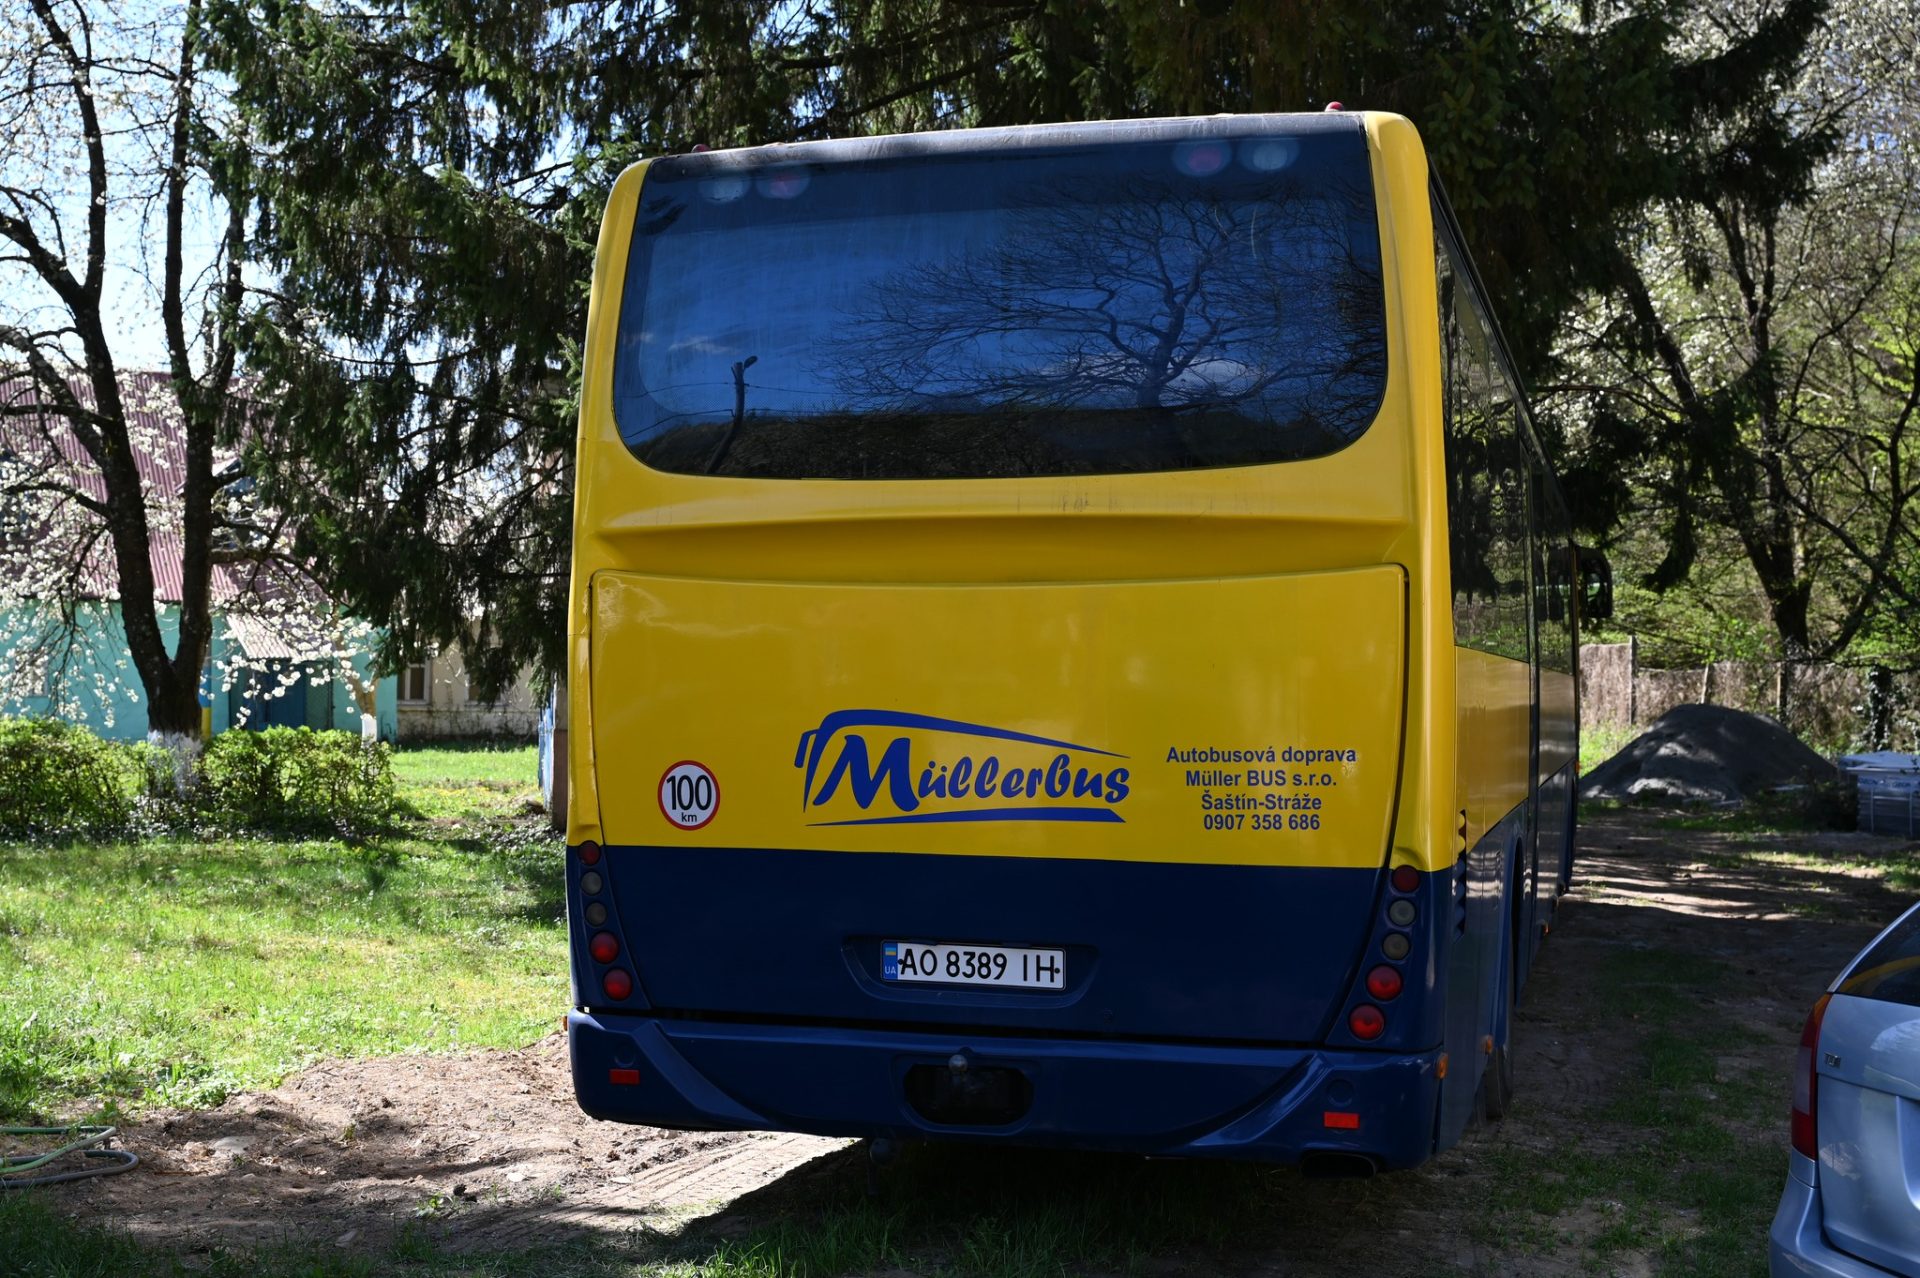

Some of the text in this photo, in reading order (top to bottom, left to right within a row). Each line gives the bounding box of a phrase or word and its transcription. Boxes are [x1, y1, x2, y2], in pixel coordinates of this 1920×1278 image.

[1166, 746, 1357, 766] Autobusová doprava
[812, 735, 1130, 812] Müllerbus
[1186, 770, 1337, 787] Müller BUS s.r.o.
[666, 774, 712, 811] 100
[1201, 789, 1322, 810] Šaštín-Stráže
[681, 812, 698, 822] km
[1203, 814, 1321, 831] 0907 358 686
[884, 965, 896, 975] UA
[900, 948, 1055, 983] AO 8389 IH
